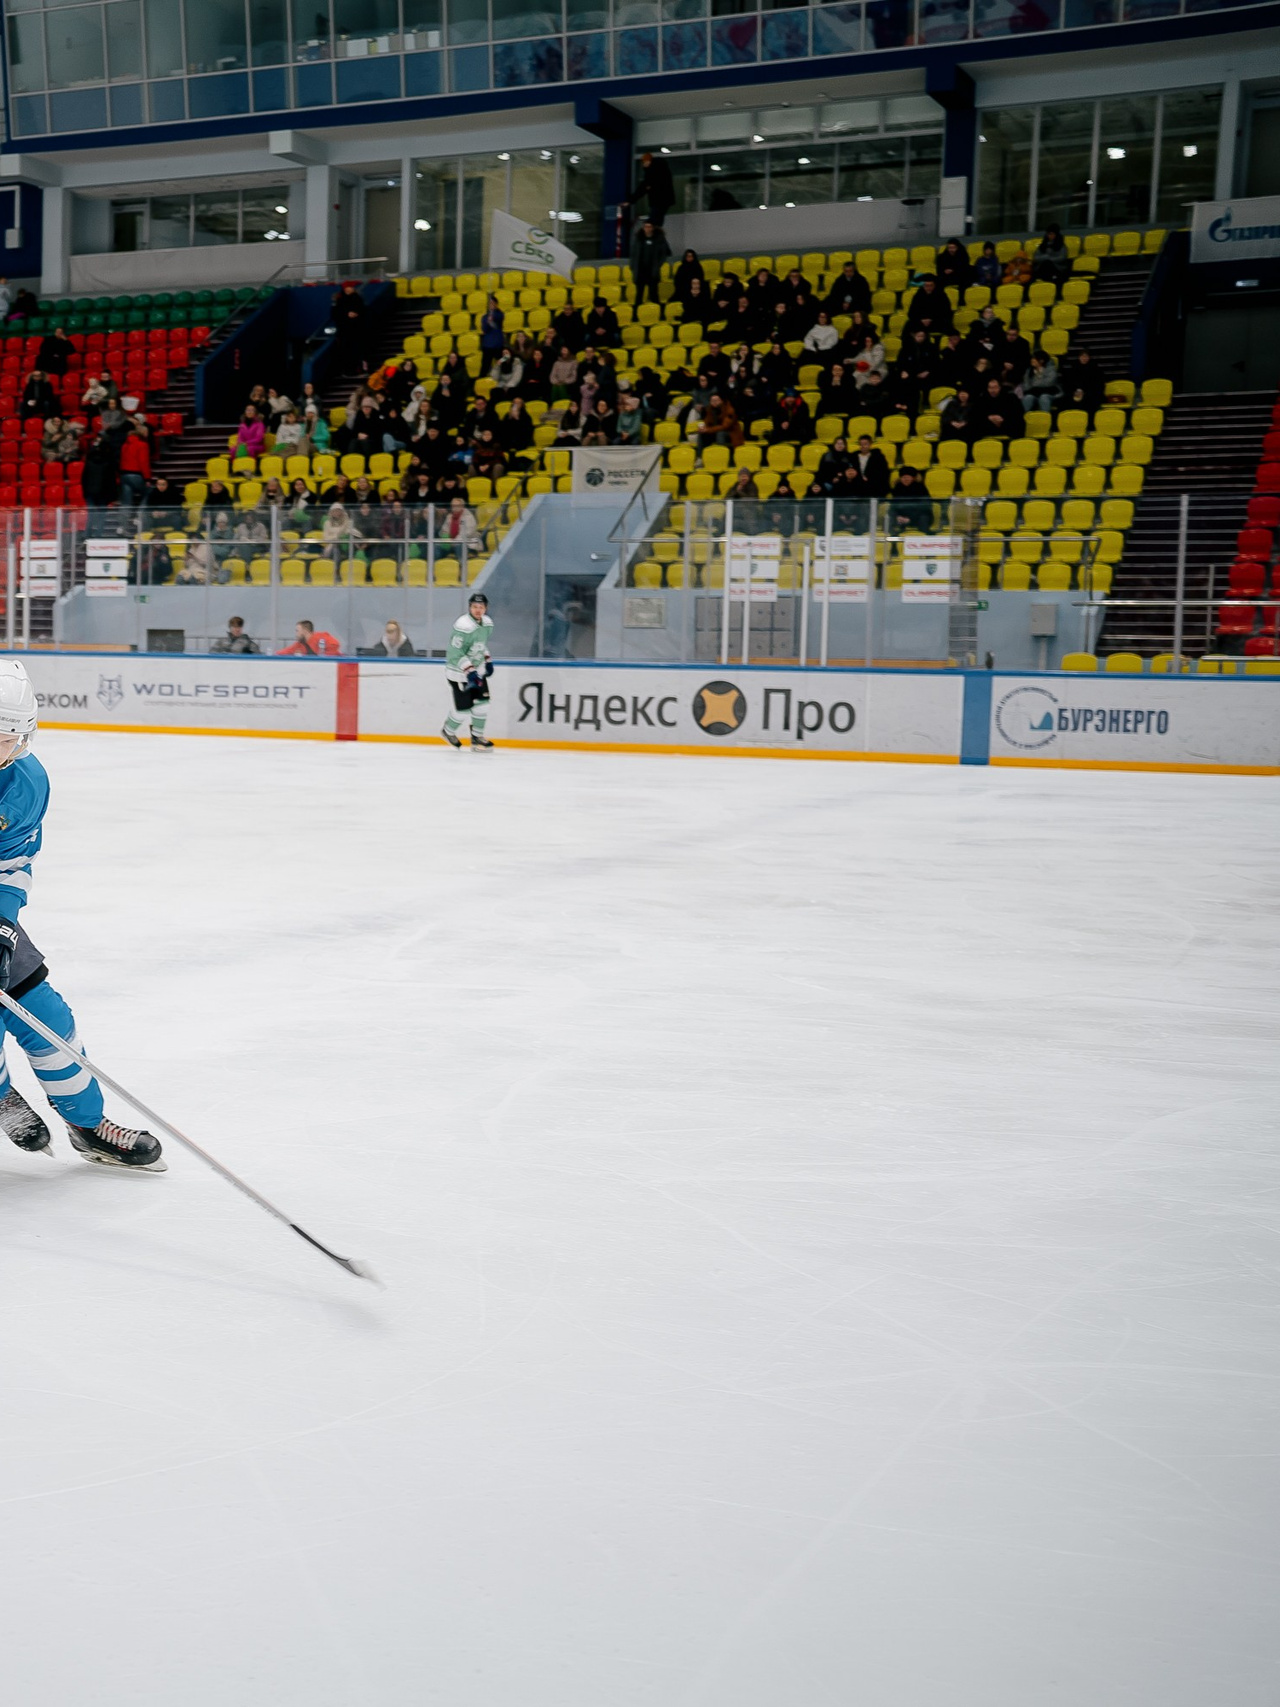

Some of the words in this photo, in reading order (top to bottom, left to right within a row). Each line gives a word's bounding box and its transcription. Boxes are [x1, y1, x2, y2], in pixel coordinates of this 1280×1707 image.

[132, 683, 311, 699] WOLFSPORT
[518, 681, 678, 732] Яндекс
[762, 687, 856, 741] Про
[1057, 707, 1169, 735] БУРЭНЕРГО
